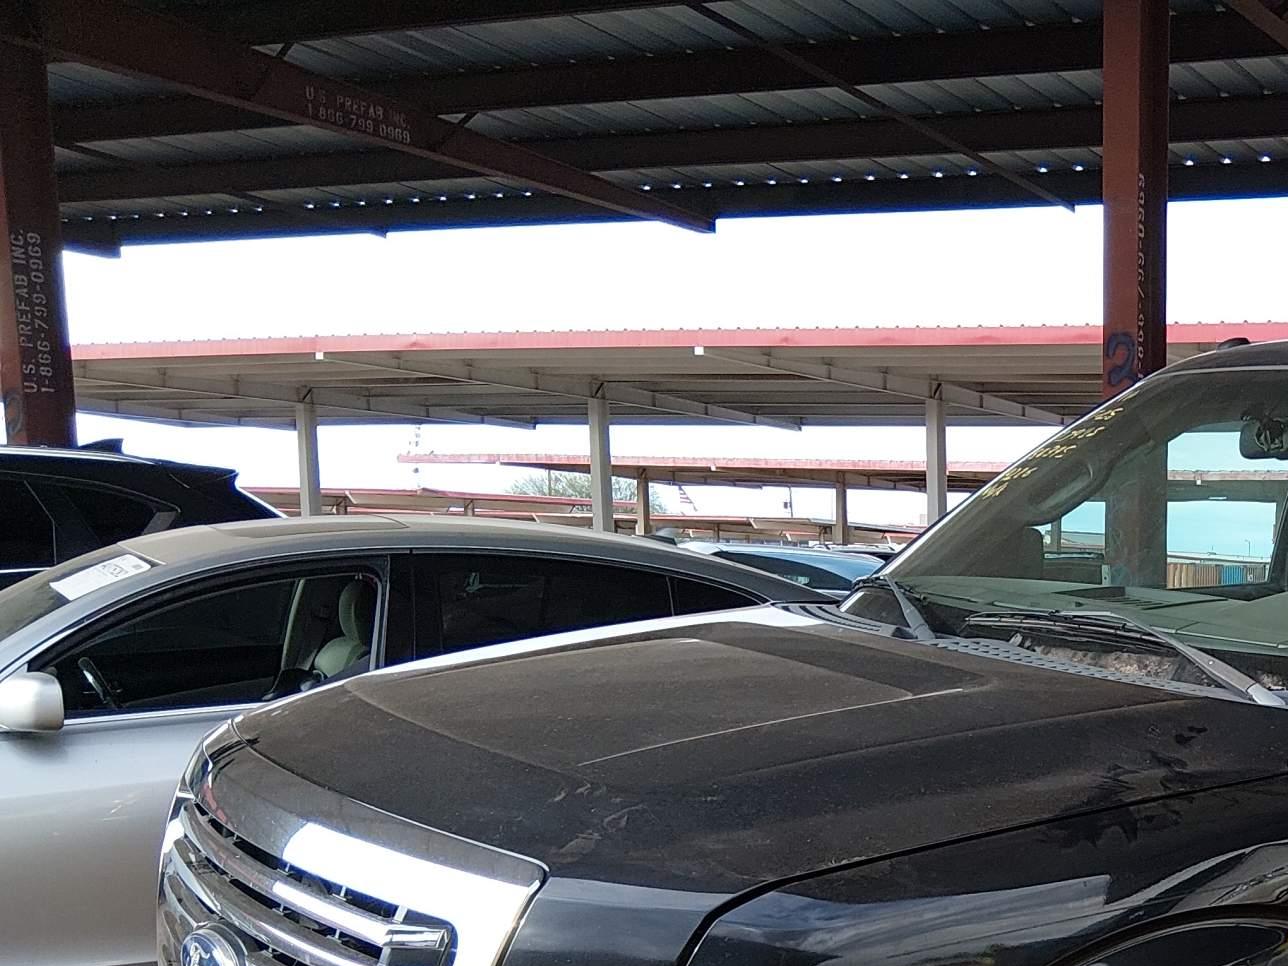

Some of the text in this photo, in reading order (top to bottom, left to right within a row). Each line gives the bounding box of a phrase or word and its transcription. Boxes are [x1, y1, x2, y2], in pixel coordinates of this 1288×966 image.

[336, 95, 384, 120] PREFAB
[10, 229, 26, 265] INC.
[14, 274, 34, 347] PREFAB
[26, 232, 56, 393] 1-866-799-0969
